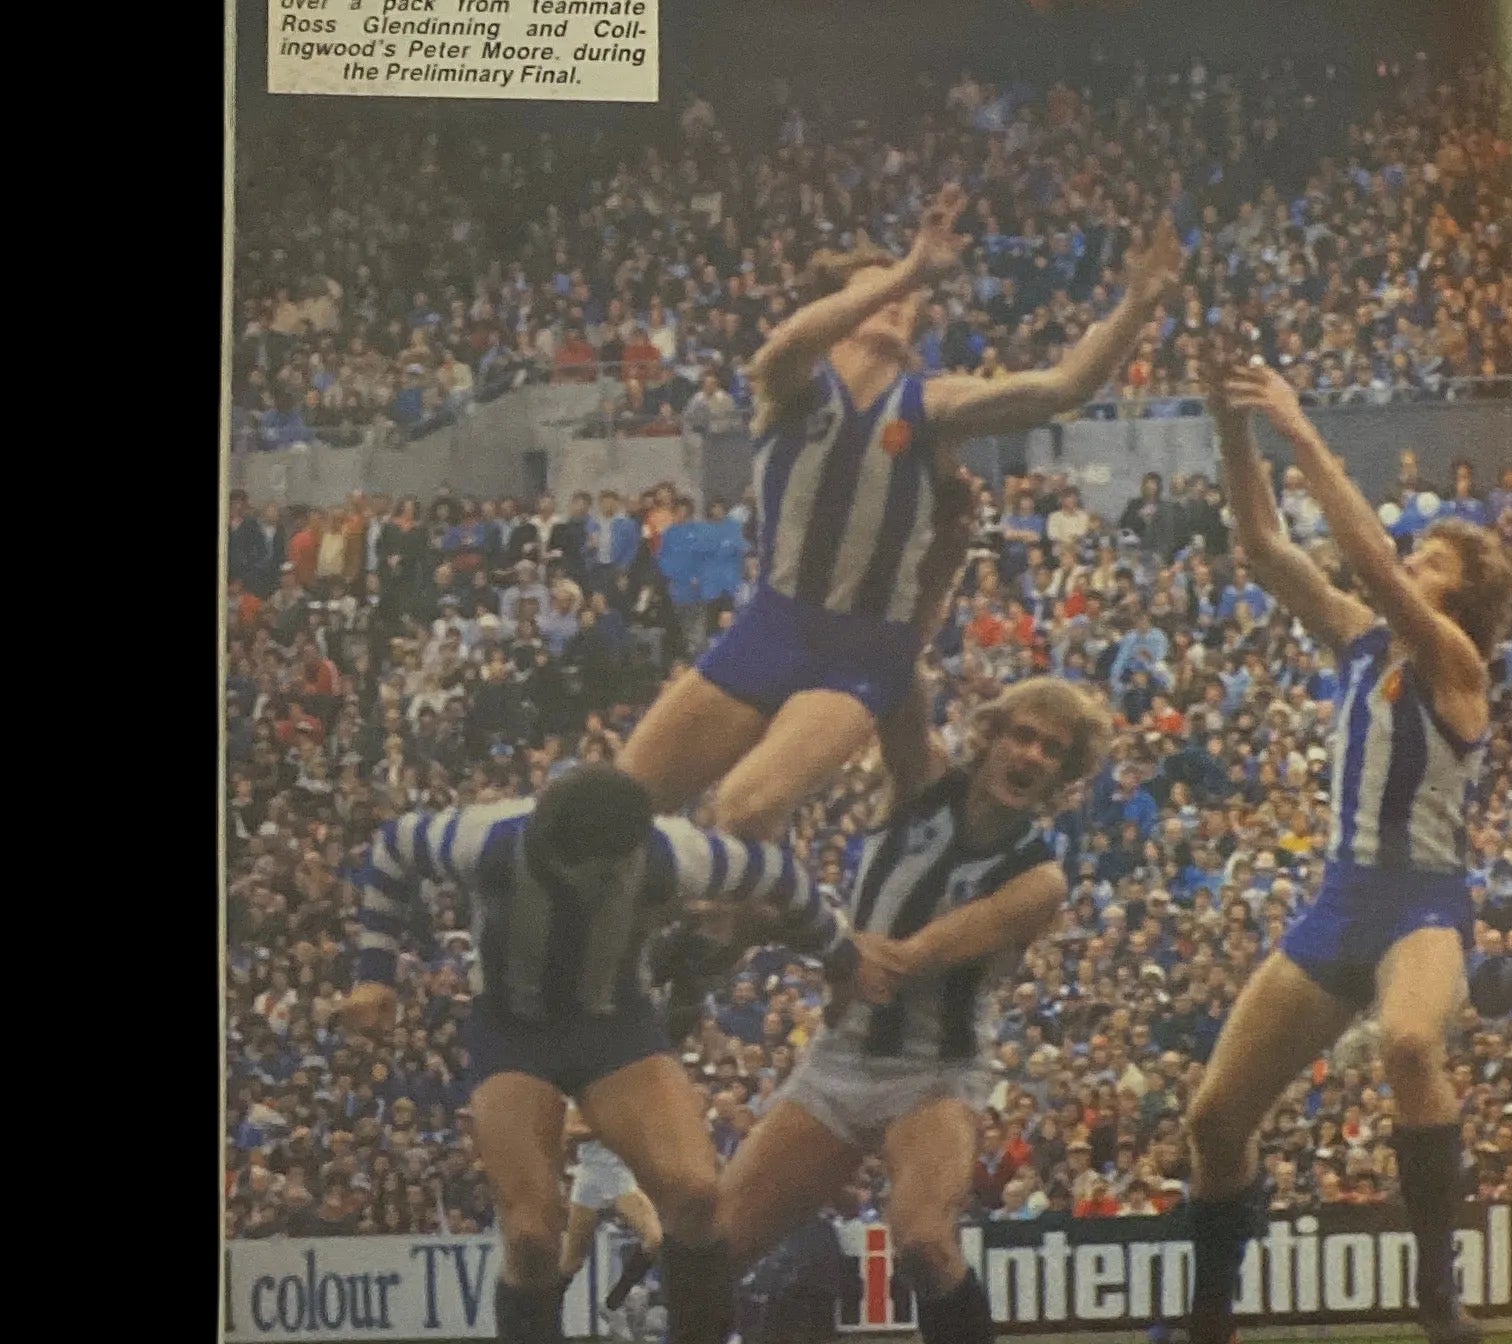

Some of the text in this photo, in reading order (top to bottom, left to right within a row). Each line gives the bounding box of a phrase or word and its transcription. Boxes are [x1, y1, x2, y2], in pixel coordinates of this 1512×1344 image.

[281, 14, 646, 40] Ross Glendinning and Coll-
[280, 38, 396, 60] ingwood's
[408, 40, 471, 58] Peter
[573, 44, 646, 66] during
[343, 63, 582, 87] the Preliminary Final.
[252, 1248, 399, 1332] colour
[409, 1242, 492, 1329] TV
